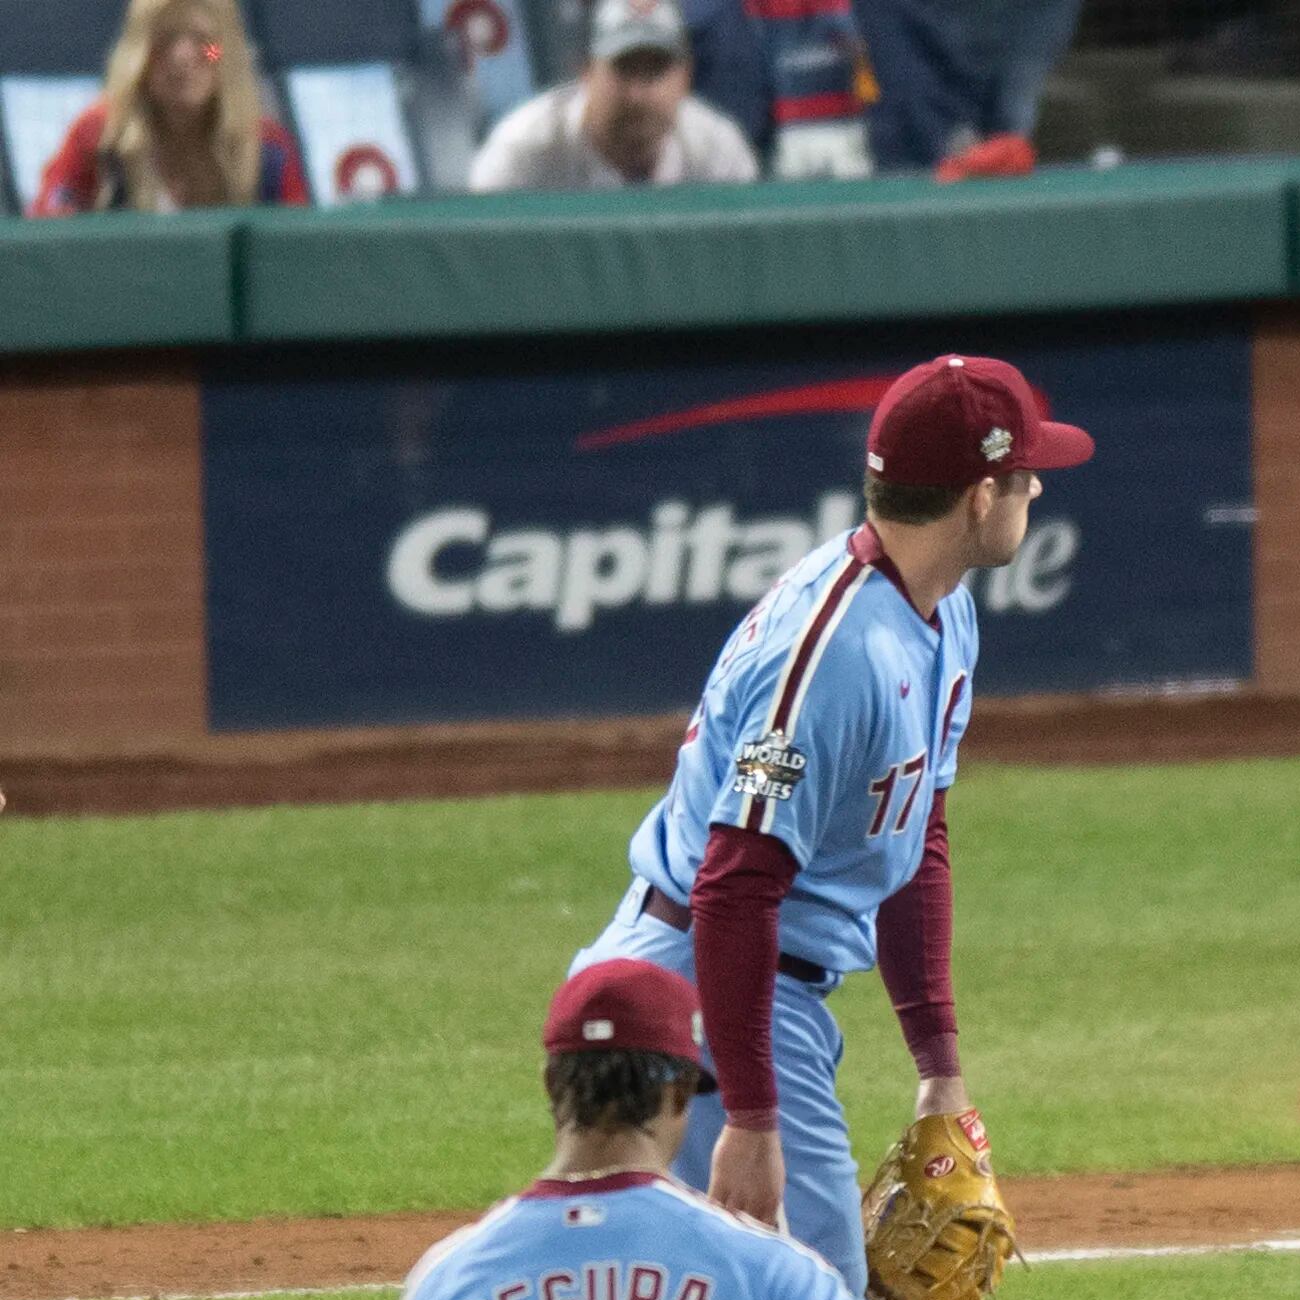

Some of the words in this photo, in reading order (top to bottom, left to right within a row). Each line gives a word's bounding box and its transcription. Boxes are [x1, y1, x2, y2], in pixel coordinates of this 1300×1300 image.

[742, 744, 807, 770] WORLD
[733, 774, 794, 800] SERIES
[866, 749, 928, 839] 17
